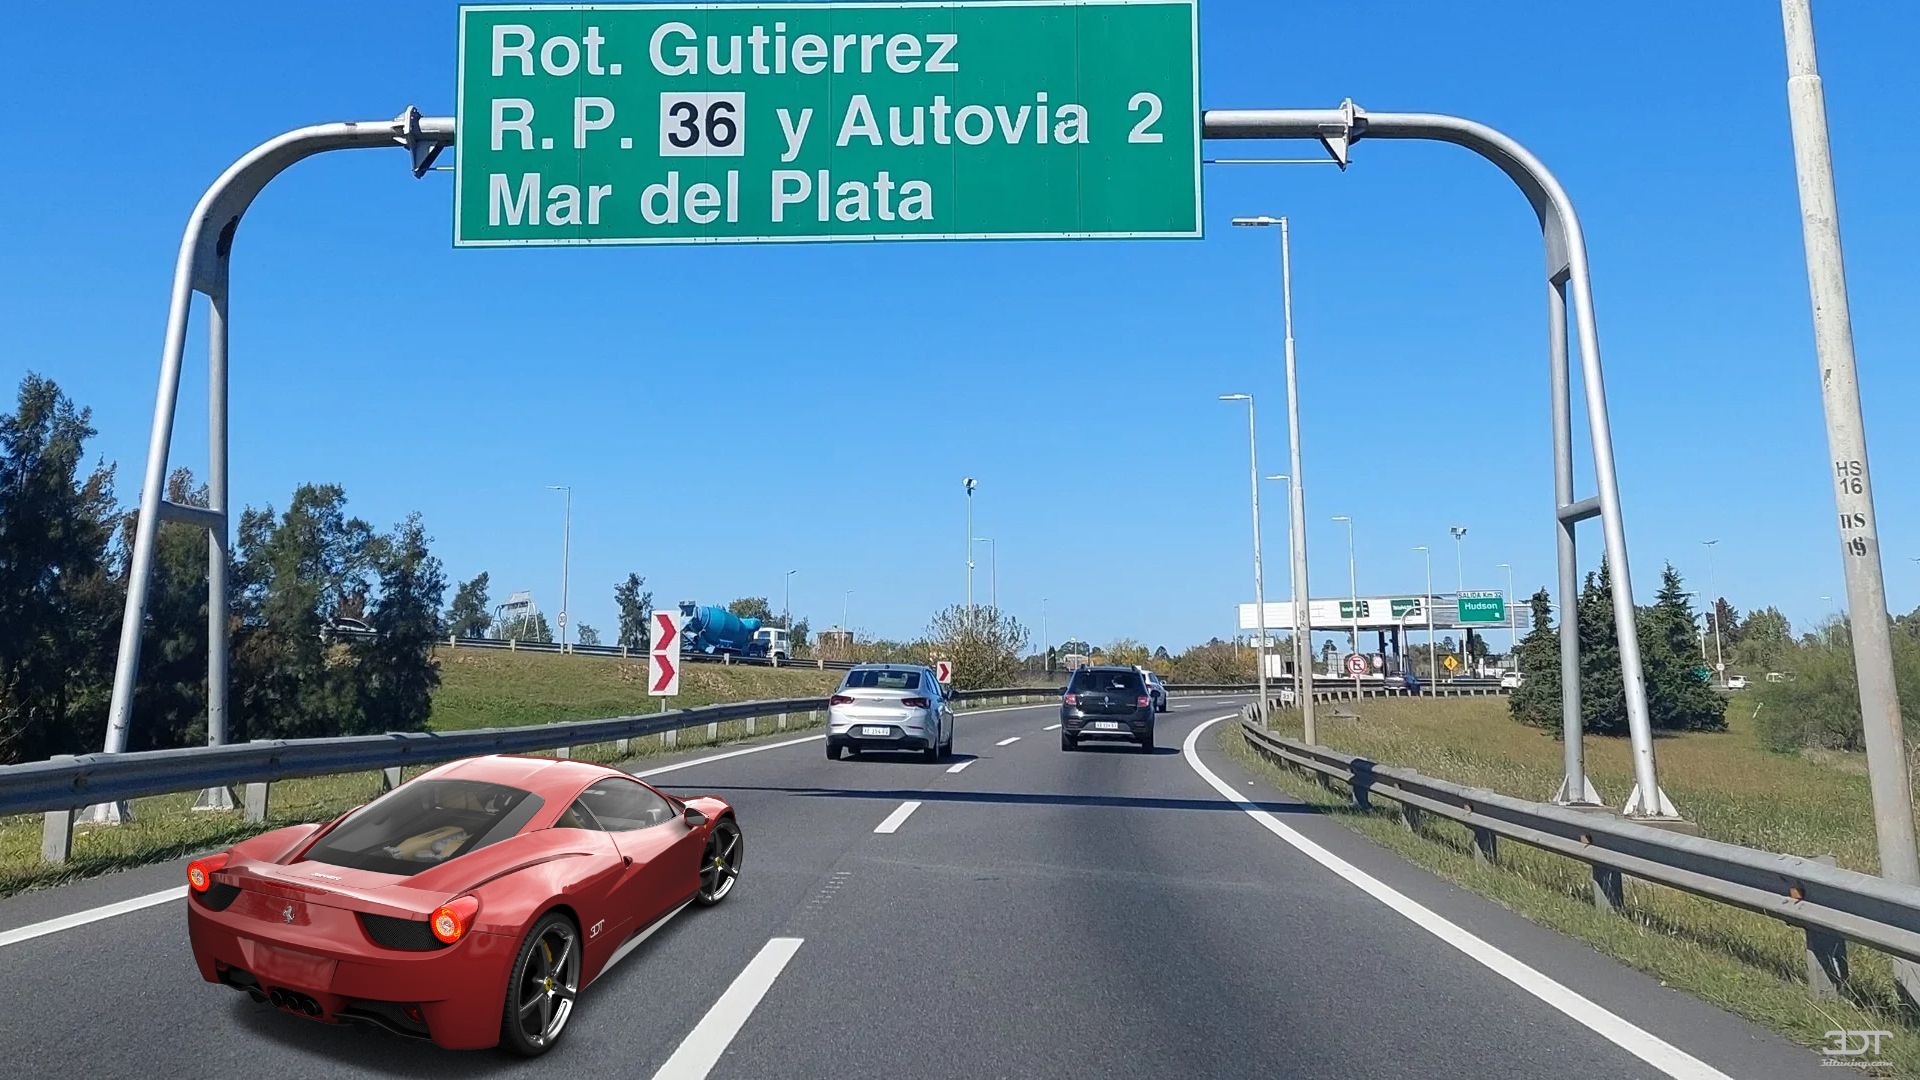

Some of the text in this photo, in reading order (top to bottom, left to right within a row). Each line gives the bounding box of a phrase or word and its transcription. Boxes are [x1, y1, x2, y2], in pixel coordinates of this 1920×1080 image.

[491, 21, 959, 77] Rot. Gutierrez
[667, 100, 737, 149] 36
[776, 108, 813, 162] y
[836, 91, 1090, 147] Autovia
[1128, 92, 1164, 144] 2
[489, 169, 934, 226] Mar del Plata
[1835, 460, 1863, 477] HS
[1839, 477, 1863, 495] 16
[1464, 602, 1498, 610] Hudson
[589, 918, 605, 939] 3DT
